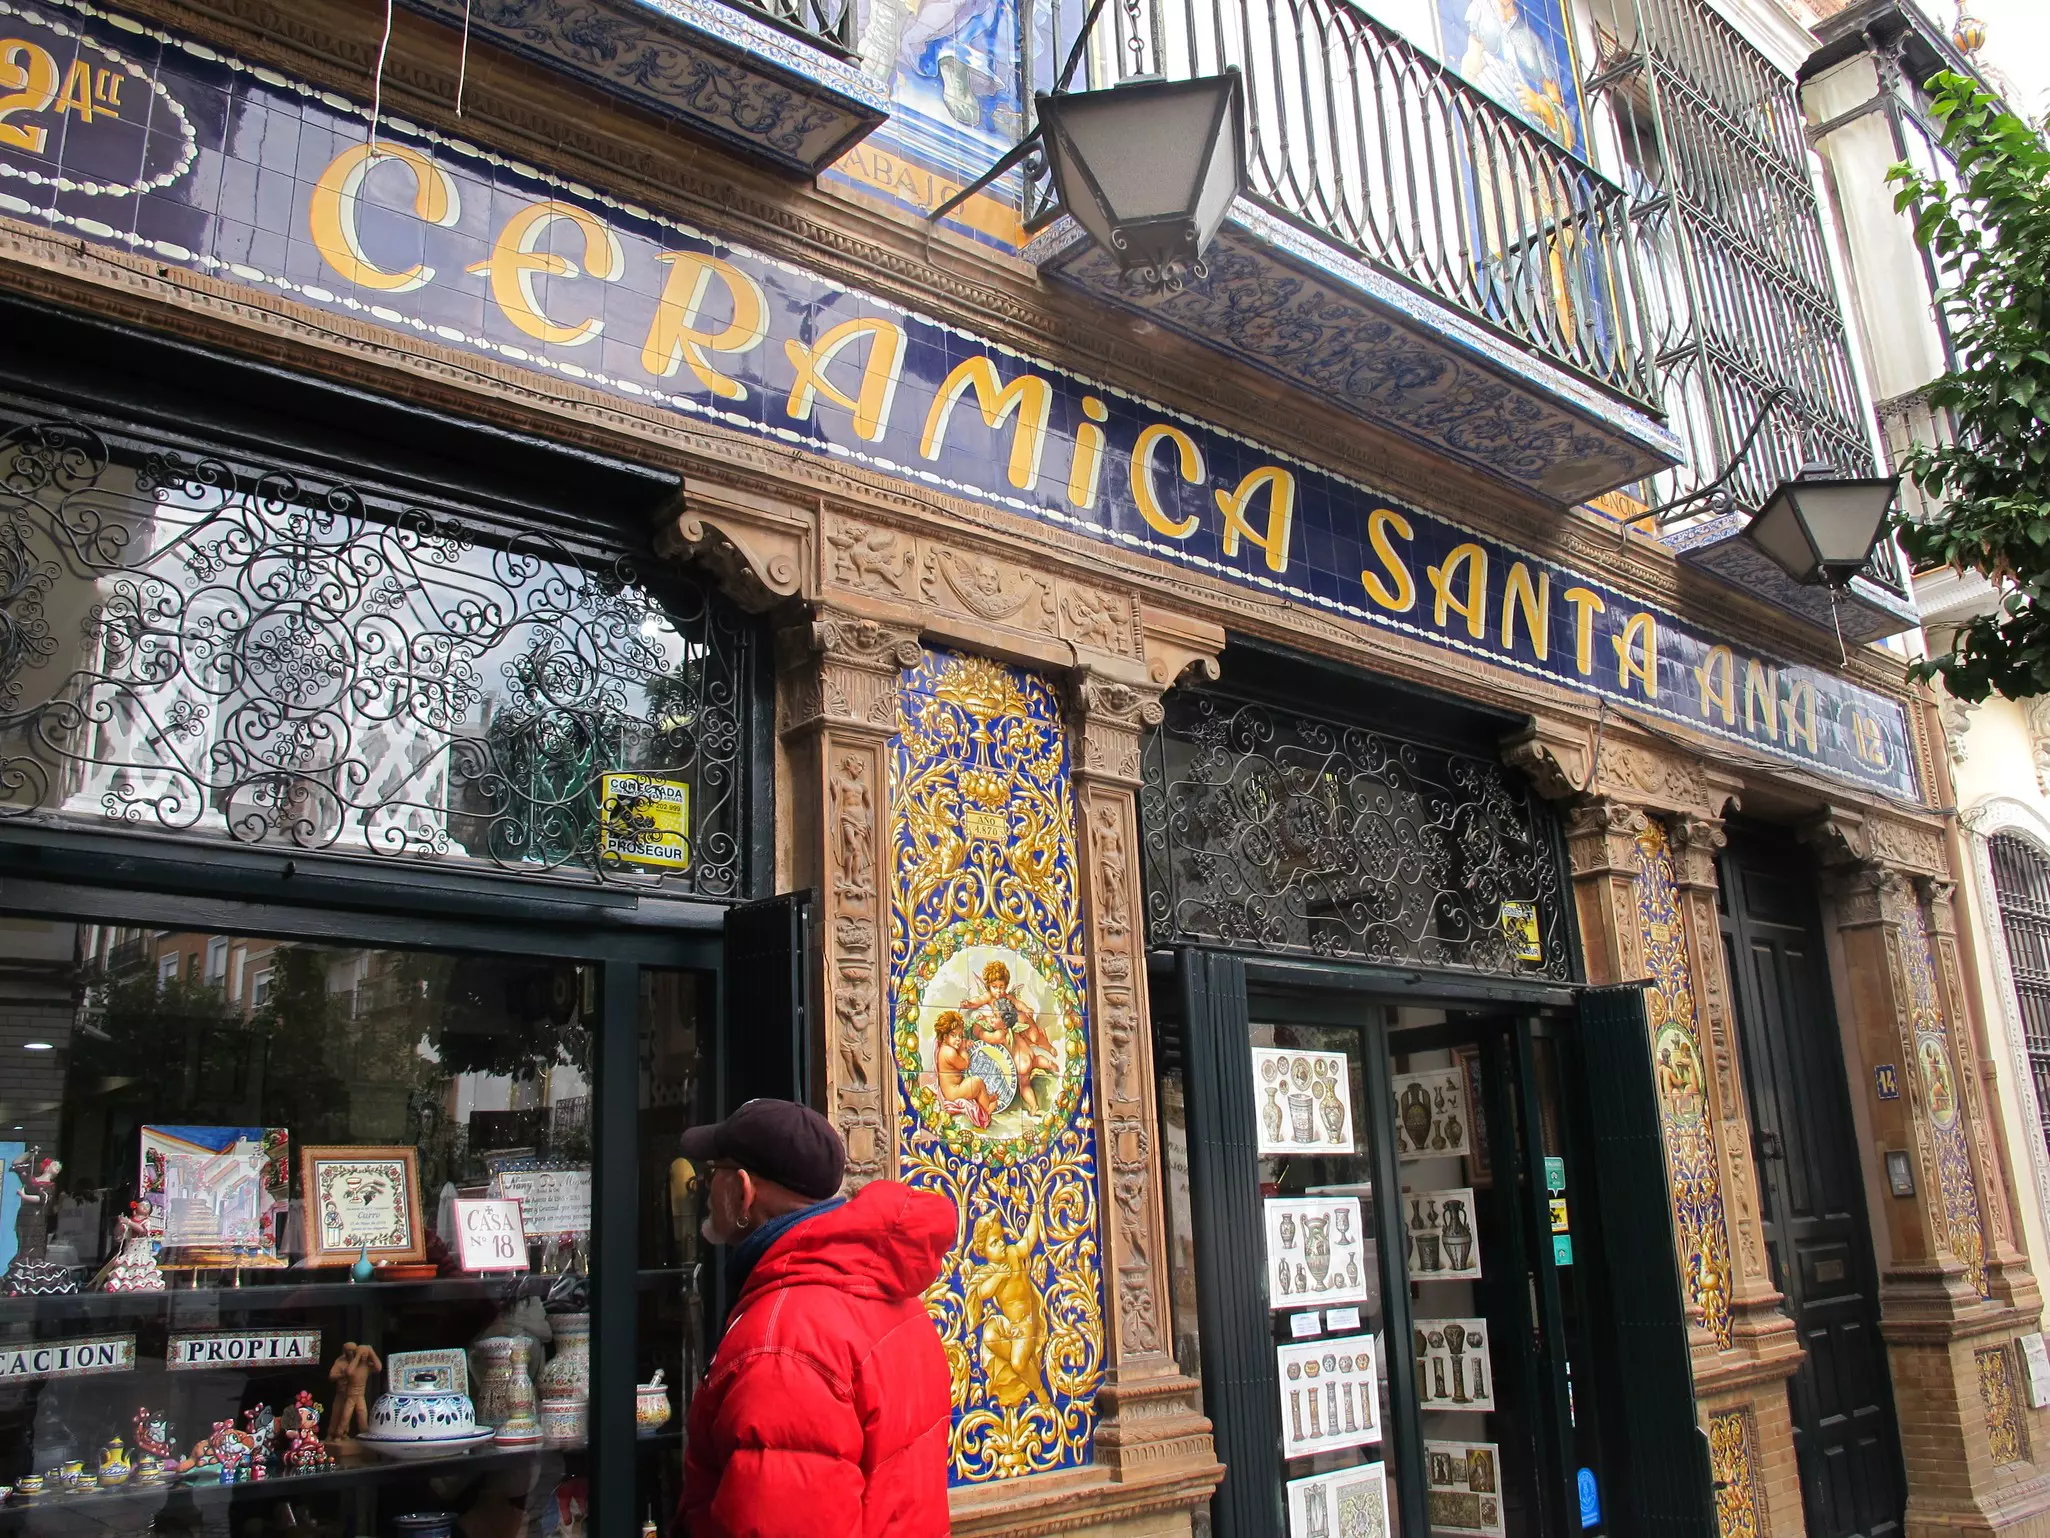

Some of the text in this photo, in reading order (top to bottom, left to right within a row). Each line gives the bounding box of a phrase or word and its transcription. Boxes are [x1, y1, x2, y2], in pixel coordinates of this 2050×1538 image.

[832, 146, 966, 218] ABAJO
[1361, 507, 1658, 699] SANTA
[1694, 643, 1819, 755] ANA
[1851, 710, 1886, 766] 12
[974, 825, 998, 836] 1870
[977, 816, 996, 827] AÑO
[467, 1208, 516, 1232] CASA
[492, 1234, 515, 1259] 18
[187, 1337, 303, 1363] PROPIA
